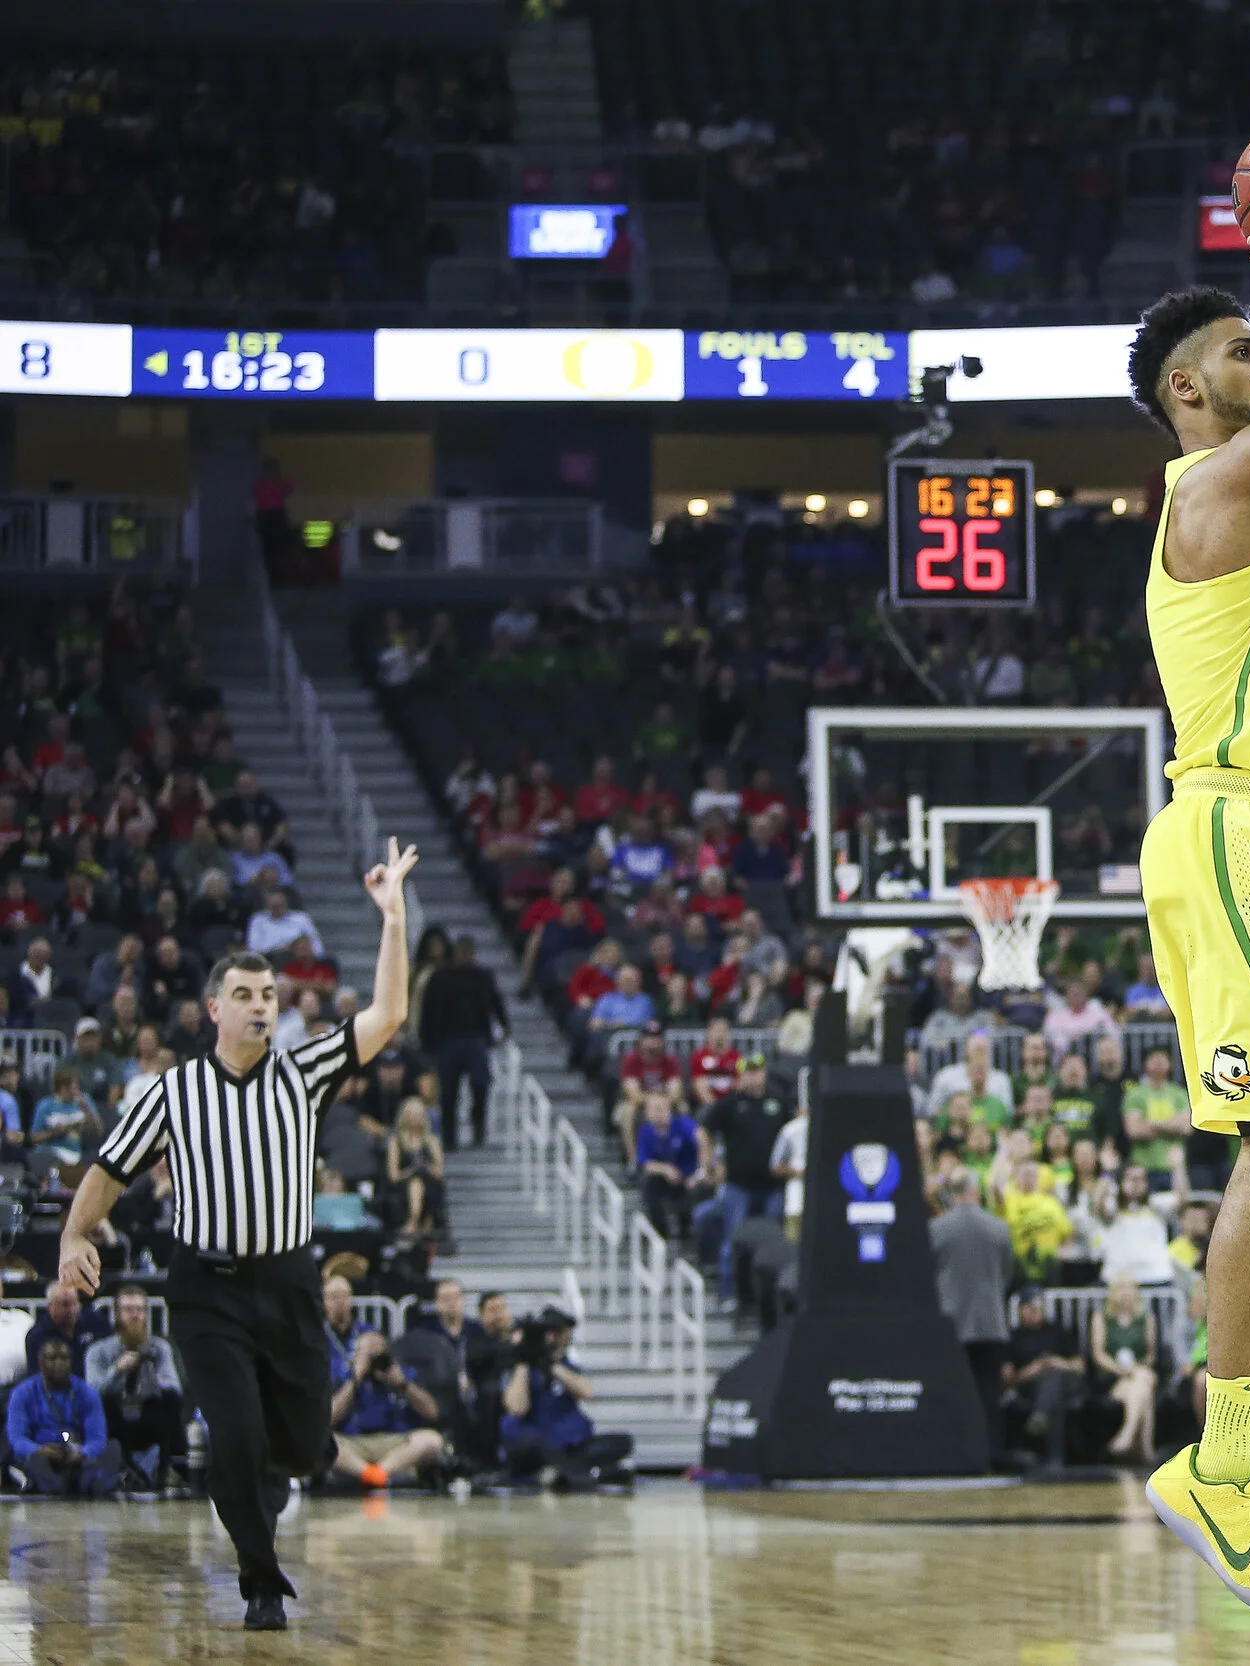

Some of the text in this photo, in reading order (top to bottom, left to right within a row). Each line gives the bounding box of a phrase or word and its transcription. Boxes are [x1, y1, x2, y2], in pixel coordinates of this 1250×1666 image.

[21, 340, 49, 378] 8
[225, 331, 282, 357] 1ST
[698, 331, 808, 360] FOULS
[182, 350, 325, 392] 16:23
[459, 349, 488, 385] 0
[737, 357, 769, 397] 1
[842, 357, 880, 397] 4
[916, 518, 1006, 591] 26
